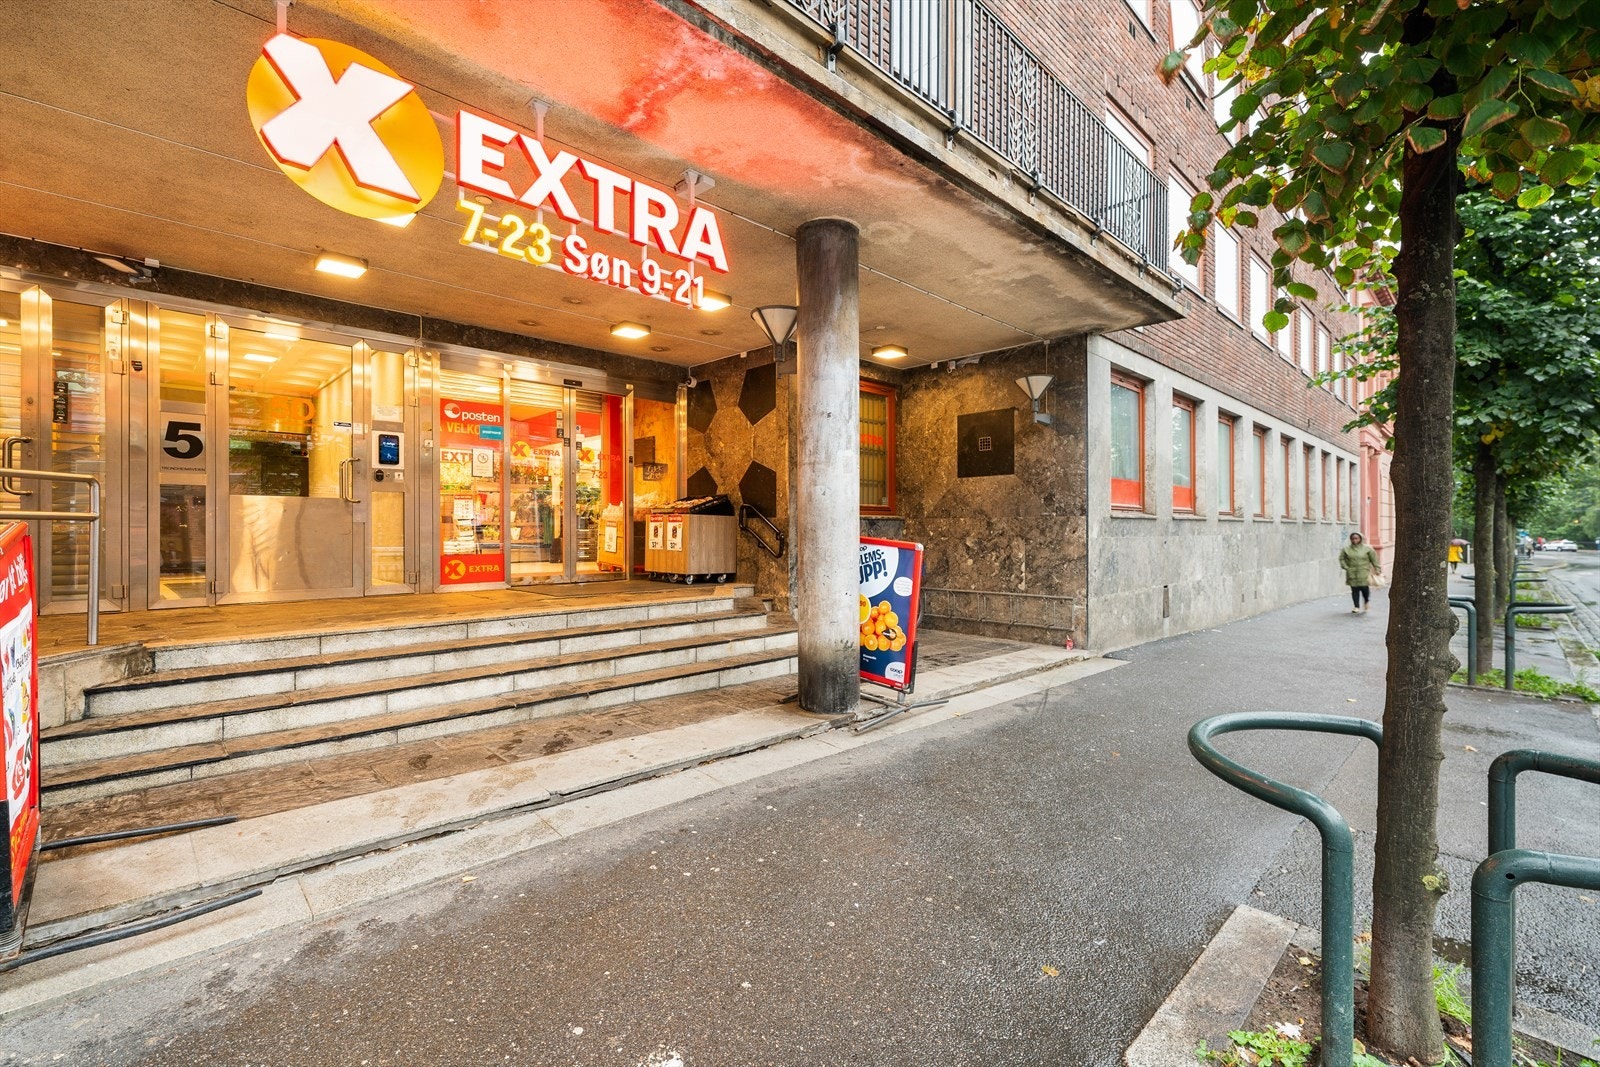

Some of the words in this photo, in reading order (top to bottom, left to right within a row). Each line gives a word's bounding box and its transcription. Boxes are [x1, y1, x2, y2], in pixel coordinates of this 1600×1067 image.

[456, 109, 730, 273] EXTRA
[456, 199, 552, 266] 7-23
[561, 235, 631, 289] Søn
[638, 259, 704, 309] 9-21
[461, 411, 501, 423] posten
[163, 421, 204, 459] 5
[533, 448, 561, 458] EXTRA
[860, 549, 884, 565] LEMS-
[469, 564, 500, 573] EXTRA
